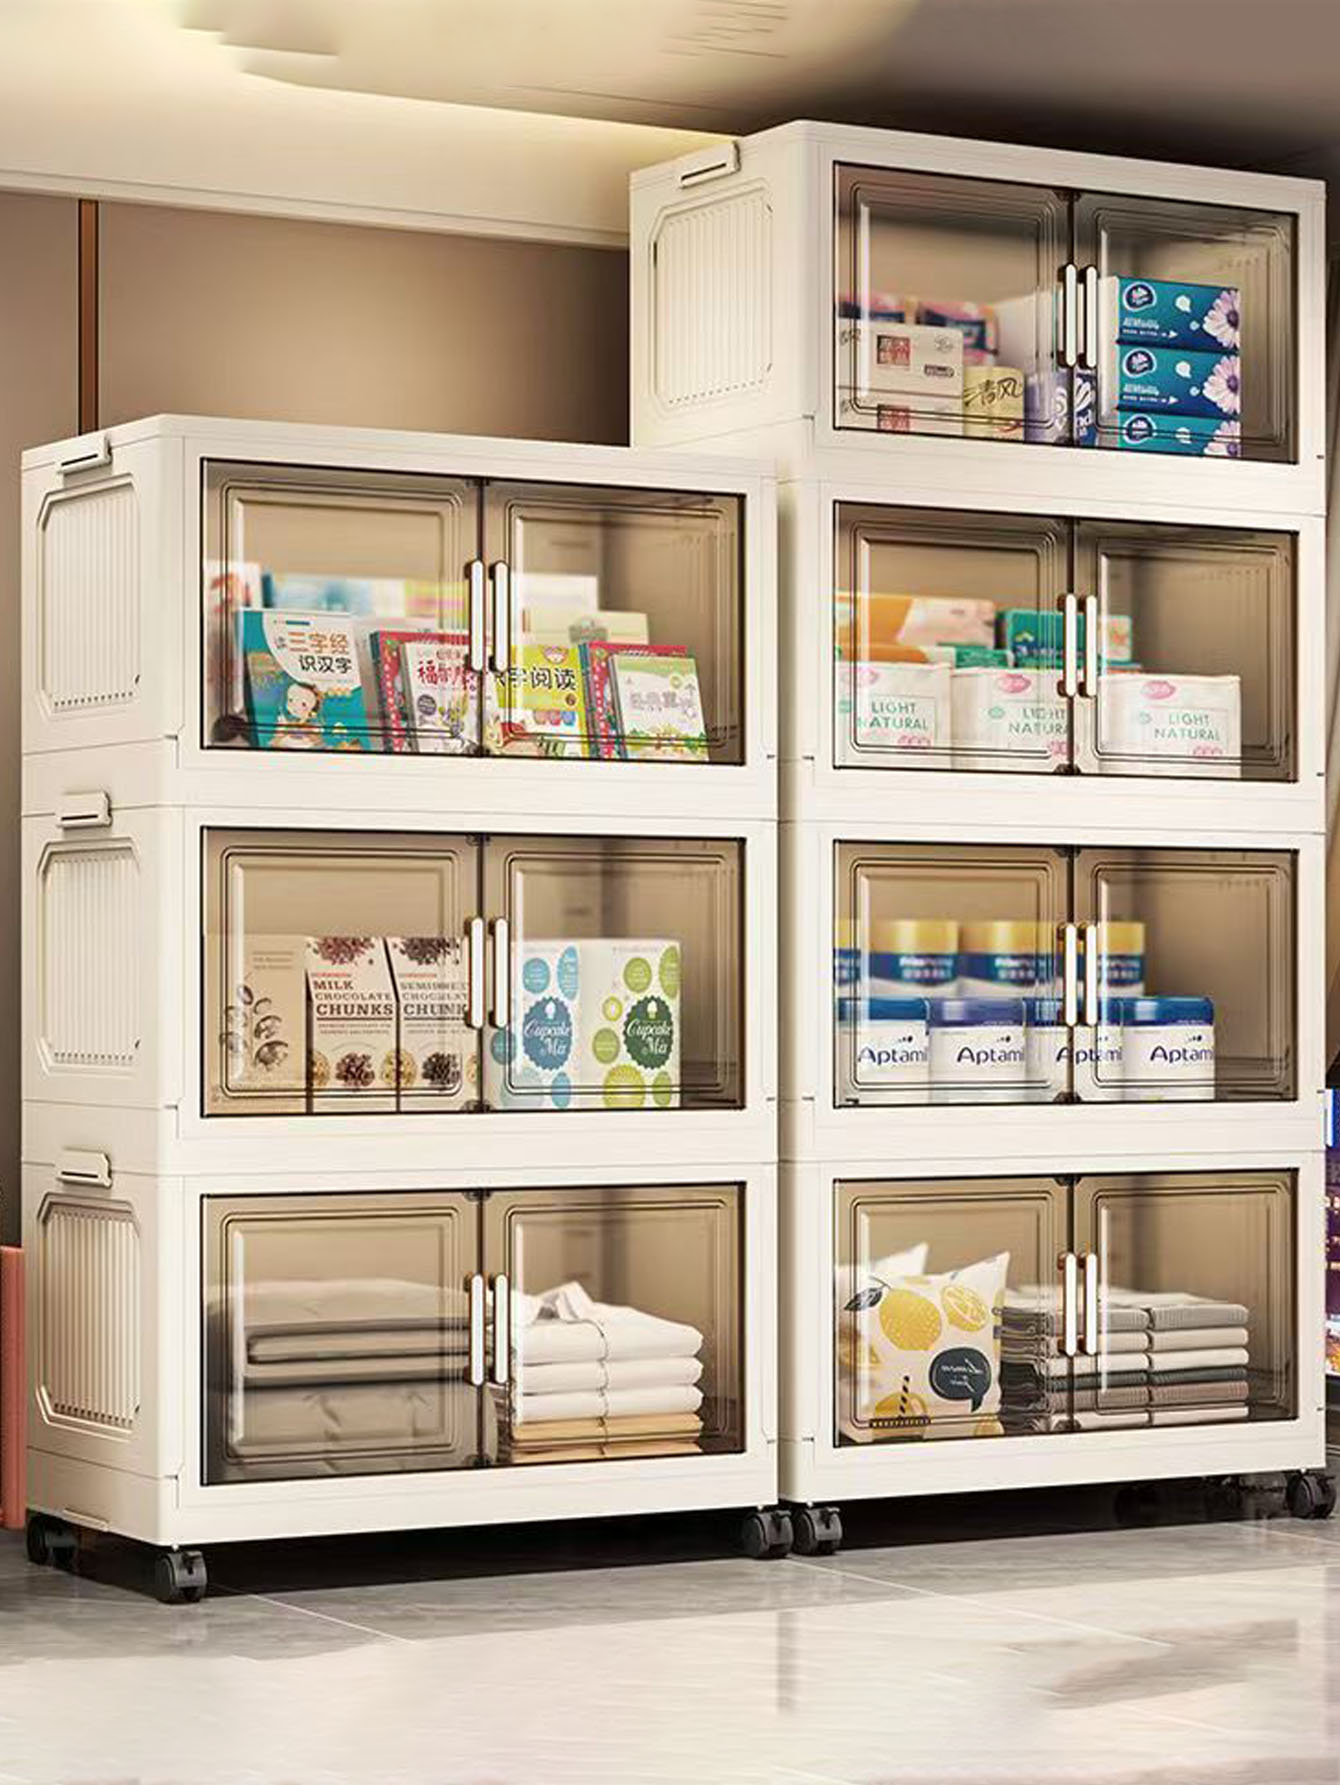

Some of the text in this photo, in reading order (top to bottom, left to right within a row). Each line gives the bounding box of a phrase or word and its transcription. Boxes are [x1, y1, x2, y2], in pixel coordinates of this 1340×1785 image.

[964, 377, 1022, 406] 清风
[288, 631, 349, 655] 三字经
[299, 655, 352, 674] 识汉字
[871, 701, 917, 715] LIGHT
[1168, 712, 1209, 726] LIGHT
[1008, 723, 1071, 735] NATURA
[1154, 728, 1221, 741] NATURAL
[313, 980, 354, 990] MILK
[314, 993, 393, 1001] CHOCOLATE
[316, 1003, 393, 1016] CHUNKS
[403, 1003, 467, 1016] CHUNK
[524, 1018, 572, 1040] Cupcake
[626, 1018, 671, 1040] Cupcake
[544, 1037, 567, 1055] Mix
[645, 1037, 668, 1055] Mix
